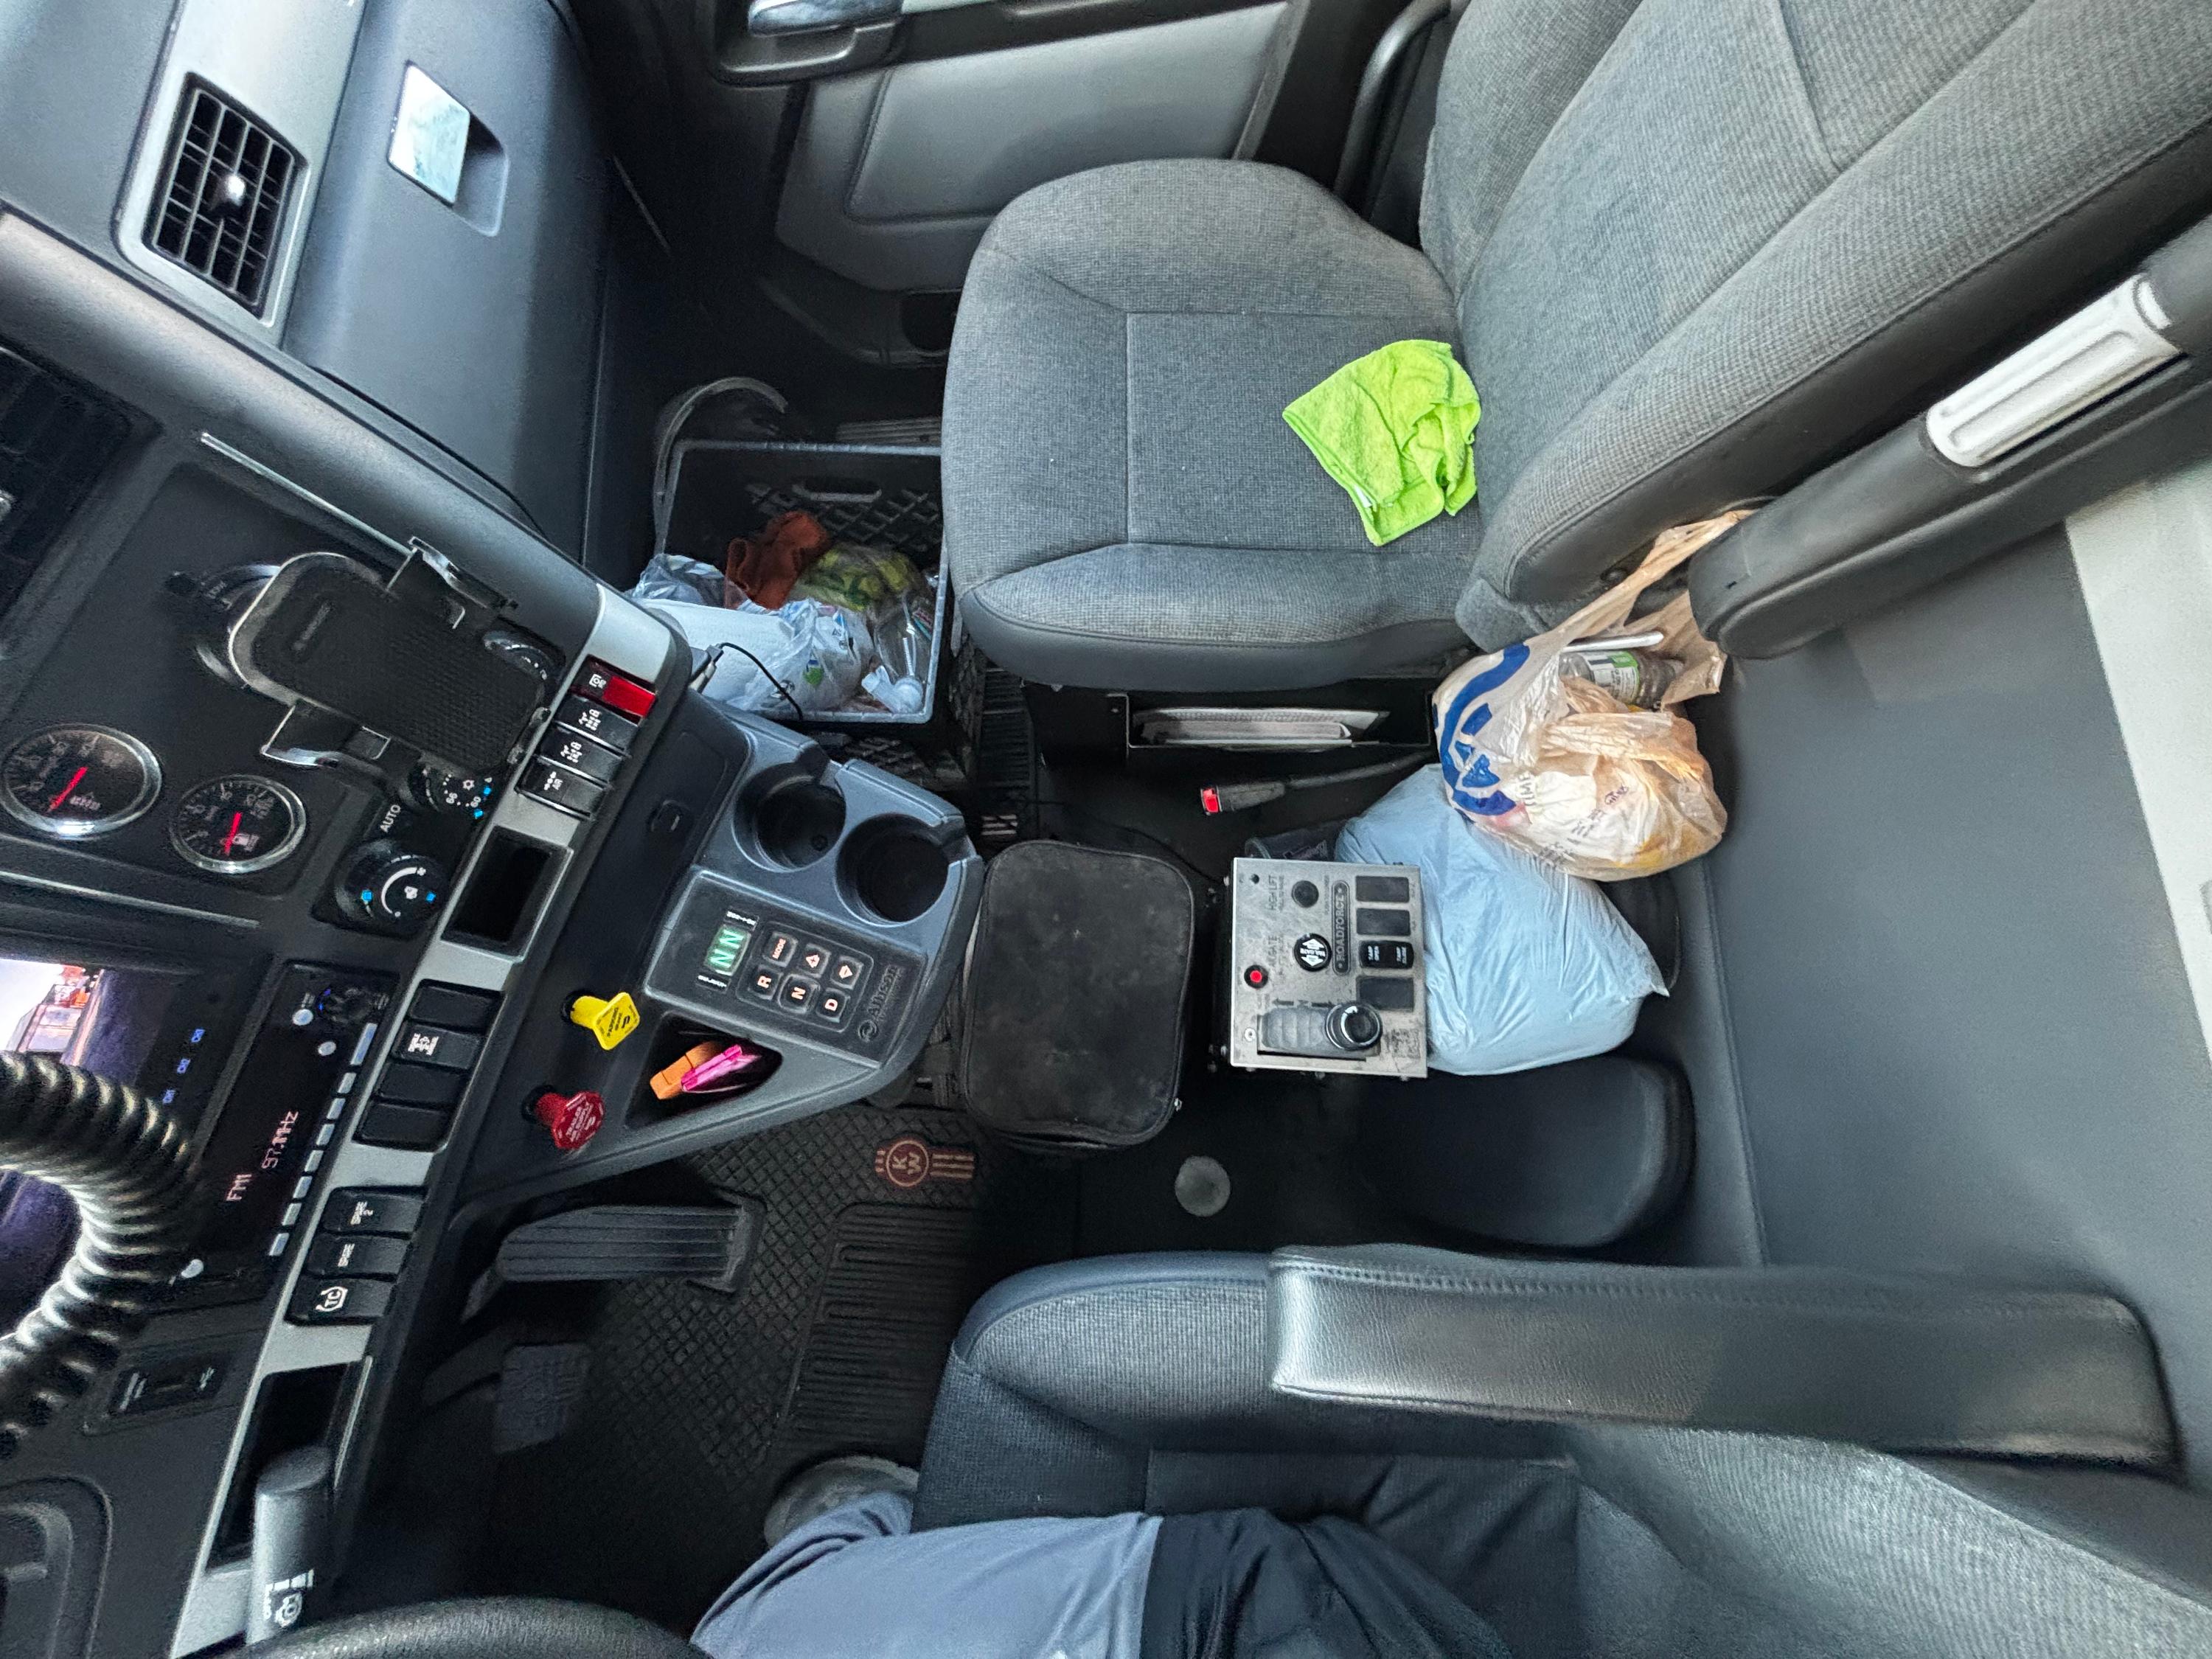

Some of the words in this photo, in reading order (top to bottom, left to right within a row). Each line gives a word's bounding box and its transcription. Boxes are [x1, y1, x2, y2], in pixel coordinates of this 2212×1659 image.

[552, 779, 563, 790] AIR
[379, 803, 402, 833] AUTO
[1335, 894, 1345, 961] ROADFORCE
[771, 937, 787, 960] MODE
[757, 975, 772, 989] R
[790, 986, 807, 1001] N
[824, 998, 839, 1012] D
[566, 1107, 582, 1136] TRAILER
[324, 1287, 342, 1307] TC
